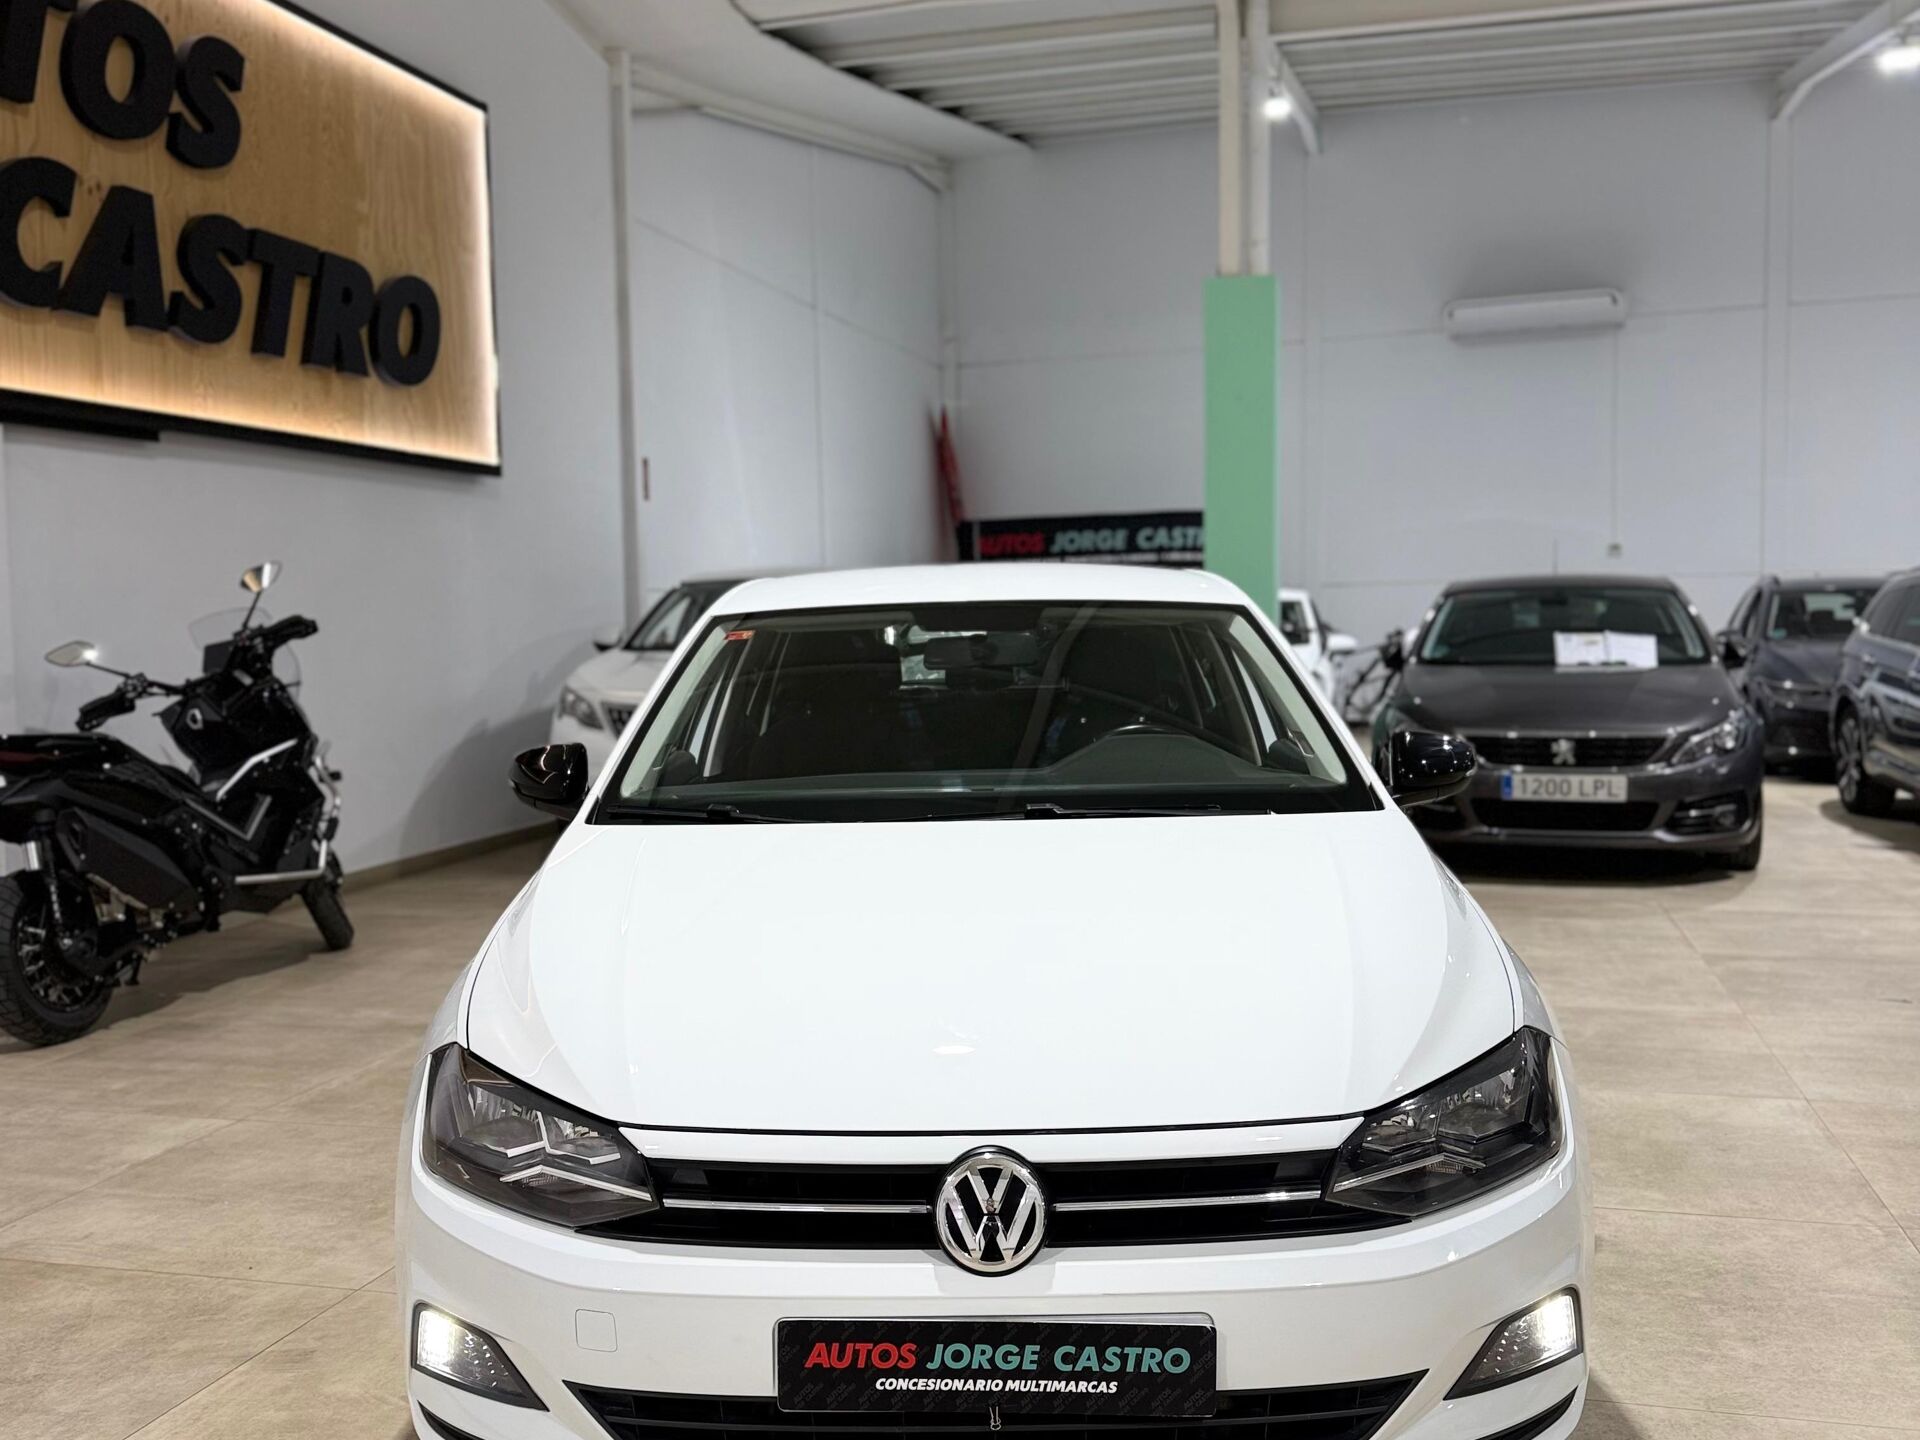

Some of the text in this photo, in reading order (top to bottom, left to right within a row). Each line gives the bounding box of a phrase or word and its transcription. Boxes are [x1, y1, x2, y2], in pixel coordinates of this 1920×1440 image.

[0, 157, 441, 387] CASTRO
[1052, 529, 1128, 552] JORGE
[1519, 777, 1621, 798] 1200 LPL
[804, 1342, 1191, 1374] AUTOS JORGE CASTRO
[875, 1377, 1118, 1394] CONCESIONARIO MULTIMARCAS
